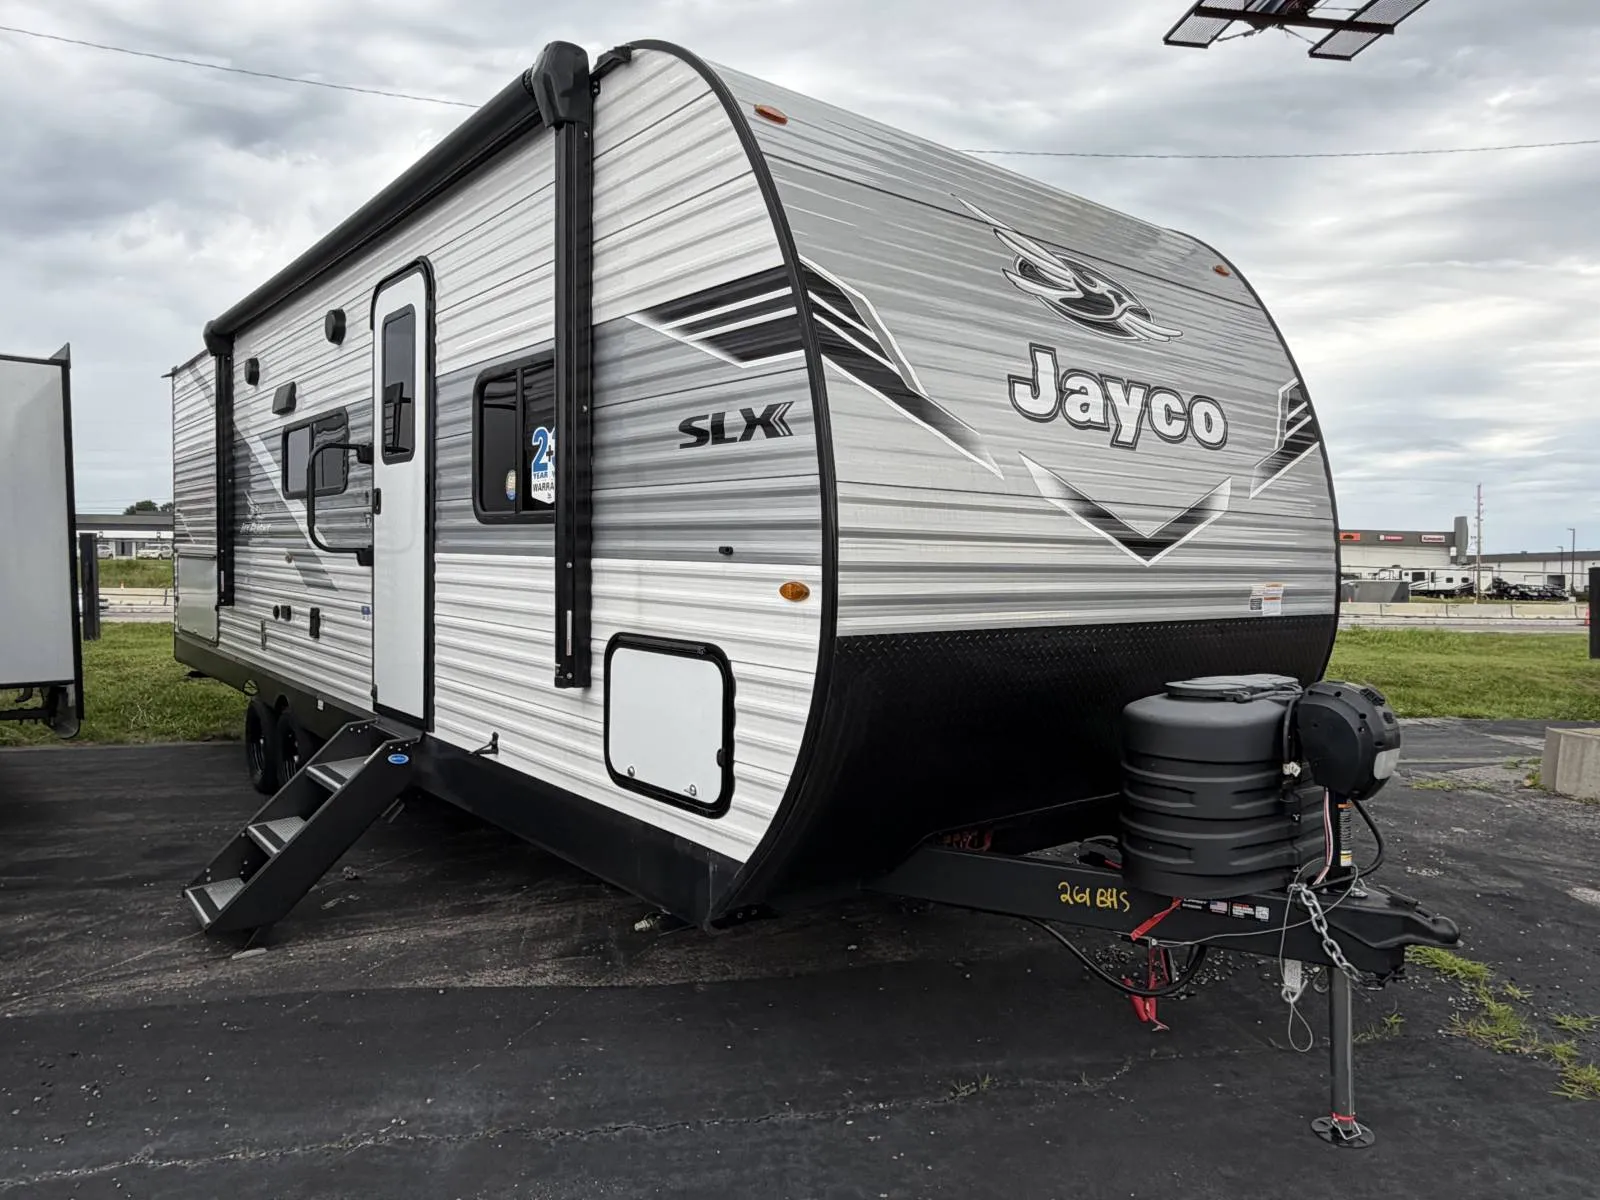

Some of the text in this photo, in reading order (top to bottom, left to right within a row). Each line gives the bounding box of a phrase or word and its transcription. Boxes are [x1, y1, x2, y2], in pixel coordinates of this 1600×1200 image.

[1008, 342, 1228, 450] Jayco
[678, 401, 794, 449] SLX
[533, 472, 548, 480] YEAR
[1058, 881, 1130, 913] 261 BHS
